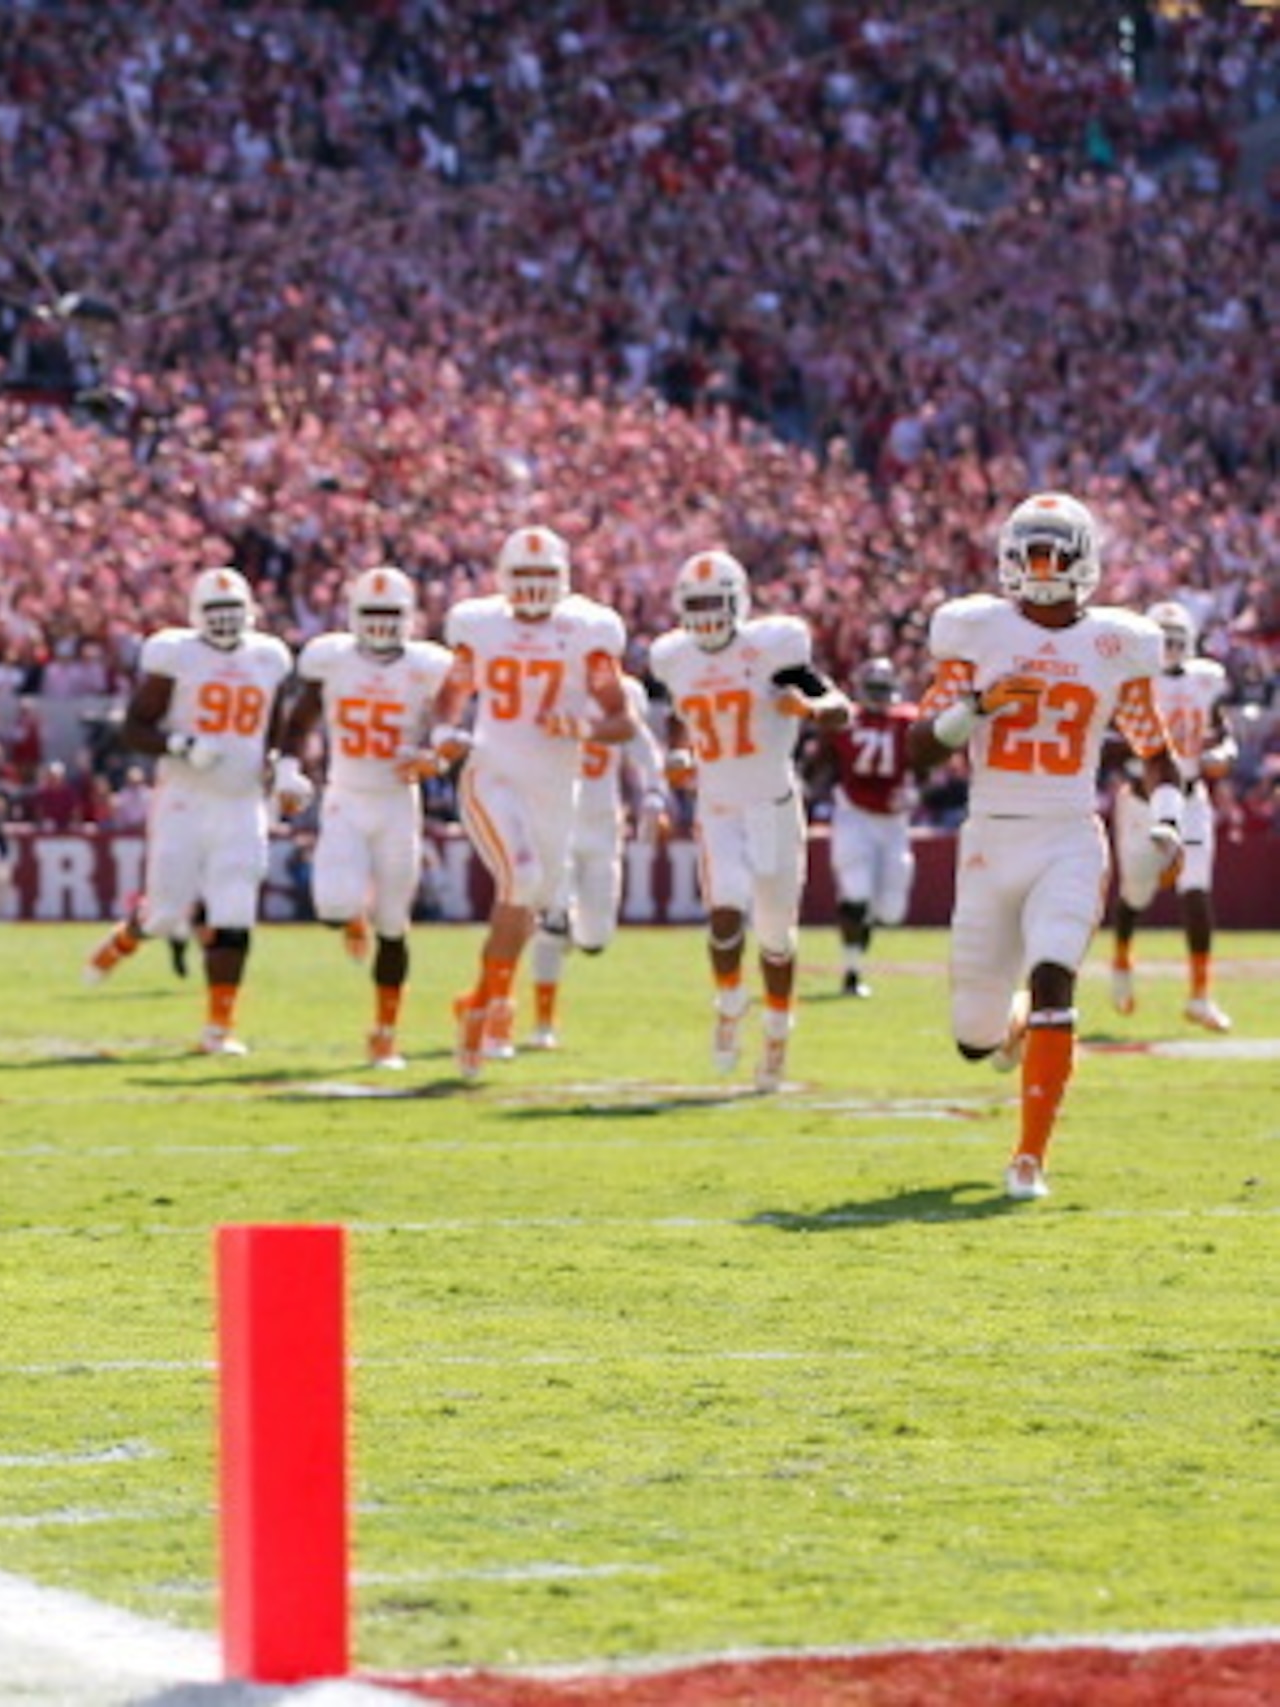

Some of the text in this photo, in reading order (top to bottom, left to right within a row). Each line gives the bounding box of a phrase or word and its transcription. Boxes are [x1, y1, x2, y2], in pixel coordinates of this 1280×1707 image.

[195, 681, 265, 737] 98
[486, 656, 564, 724] 97
[335, 697, 405, 760] 55
[851, 728, 897, 778] 71
[986, 682, 1101, 776] 23
